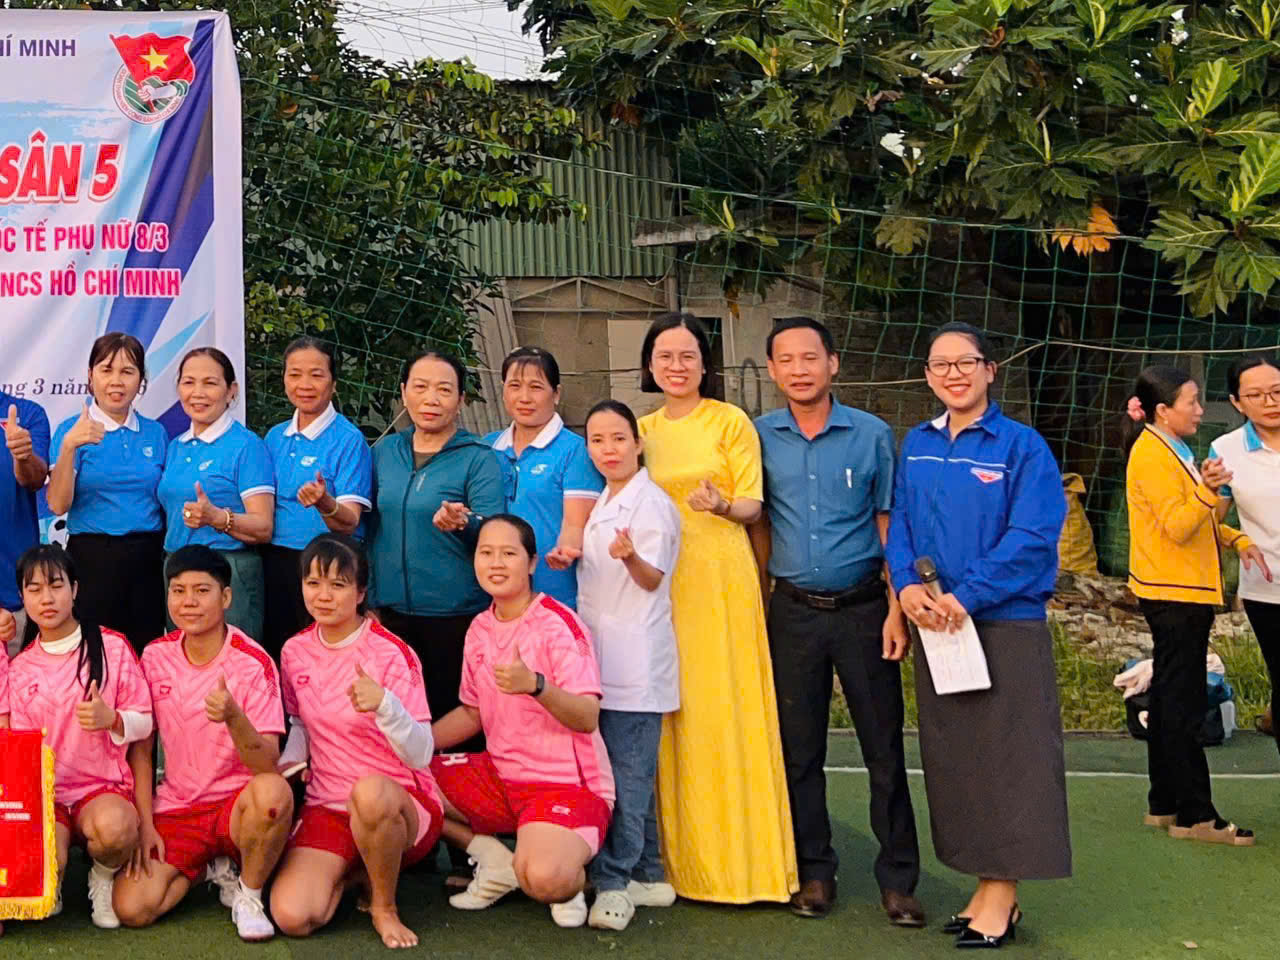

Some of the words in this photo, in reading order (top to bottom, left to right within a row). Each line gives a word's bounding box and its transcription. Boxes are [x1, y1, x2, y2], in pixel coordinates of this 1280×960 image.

[19, 38, 77, 58] MINH
[91, 142, 121, 202] 5
[23, 218, 49, 253] TẾ
[53, 224, 95, 255] PHỤ
[101, 219, 132, 251] NỮ
[135, 224, 169, 251] 8/3
[49, 260, 76, 297] HỒ
[83, 264, 119, 296] CHÍ
[123, 269, 181, 297] MINH
[32, 378, 45, 395] 3
